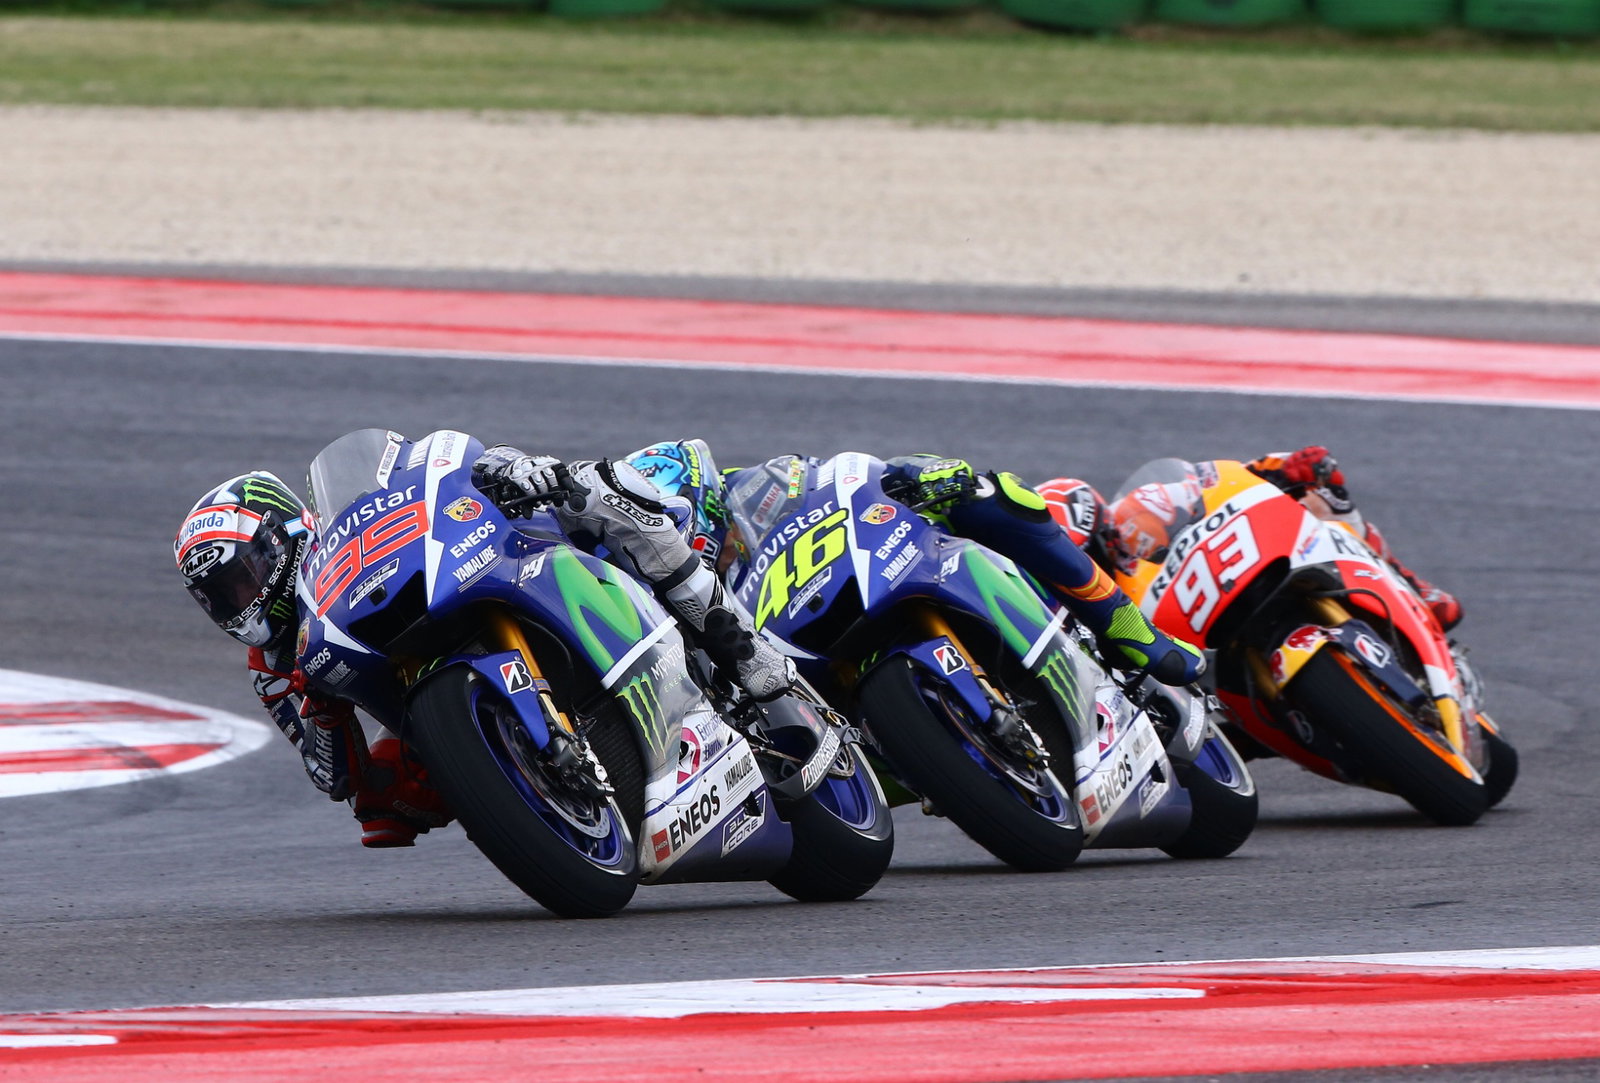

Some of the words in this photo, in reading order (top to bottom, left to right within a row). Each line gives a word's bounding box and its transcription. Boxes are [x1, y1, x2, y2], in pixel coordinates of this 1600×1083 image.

[602, 493, 664, 527] alpinestars
[309, 484, 417, 580] movistar
[449, 520, 497, 559] ENEOS
[741, 500, 834, 603] movistar
[874, 520, 912, 561] ENEOS
[1150, 502, 1242, 601] REPSOL
[184, 548, 216, 575] HJC
[268, 553, 288, 586] SECTOR
[282, 537, 306, 598] MONSTER
[314, 499, 430, 620] 99
[452, 544, 498, 583] YAMALUBE
[753, 507, 850, 633] 46
[880, 541, 920, 582] YAMALUBE
[1173, 512, 1262, 634] 93
[240, 586, 271, 621] SECTOR
[304, 647, 332, 677] ENEOS
[663, 669, 689, 693] ENERG
[723, 752, 754, 792] YAMALUBE
[1096, 753, 1133, 815] ENEOS
[668, 784, 721, 853] ENEOS
[727, 818, 760, 850] CORE
